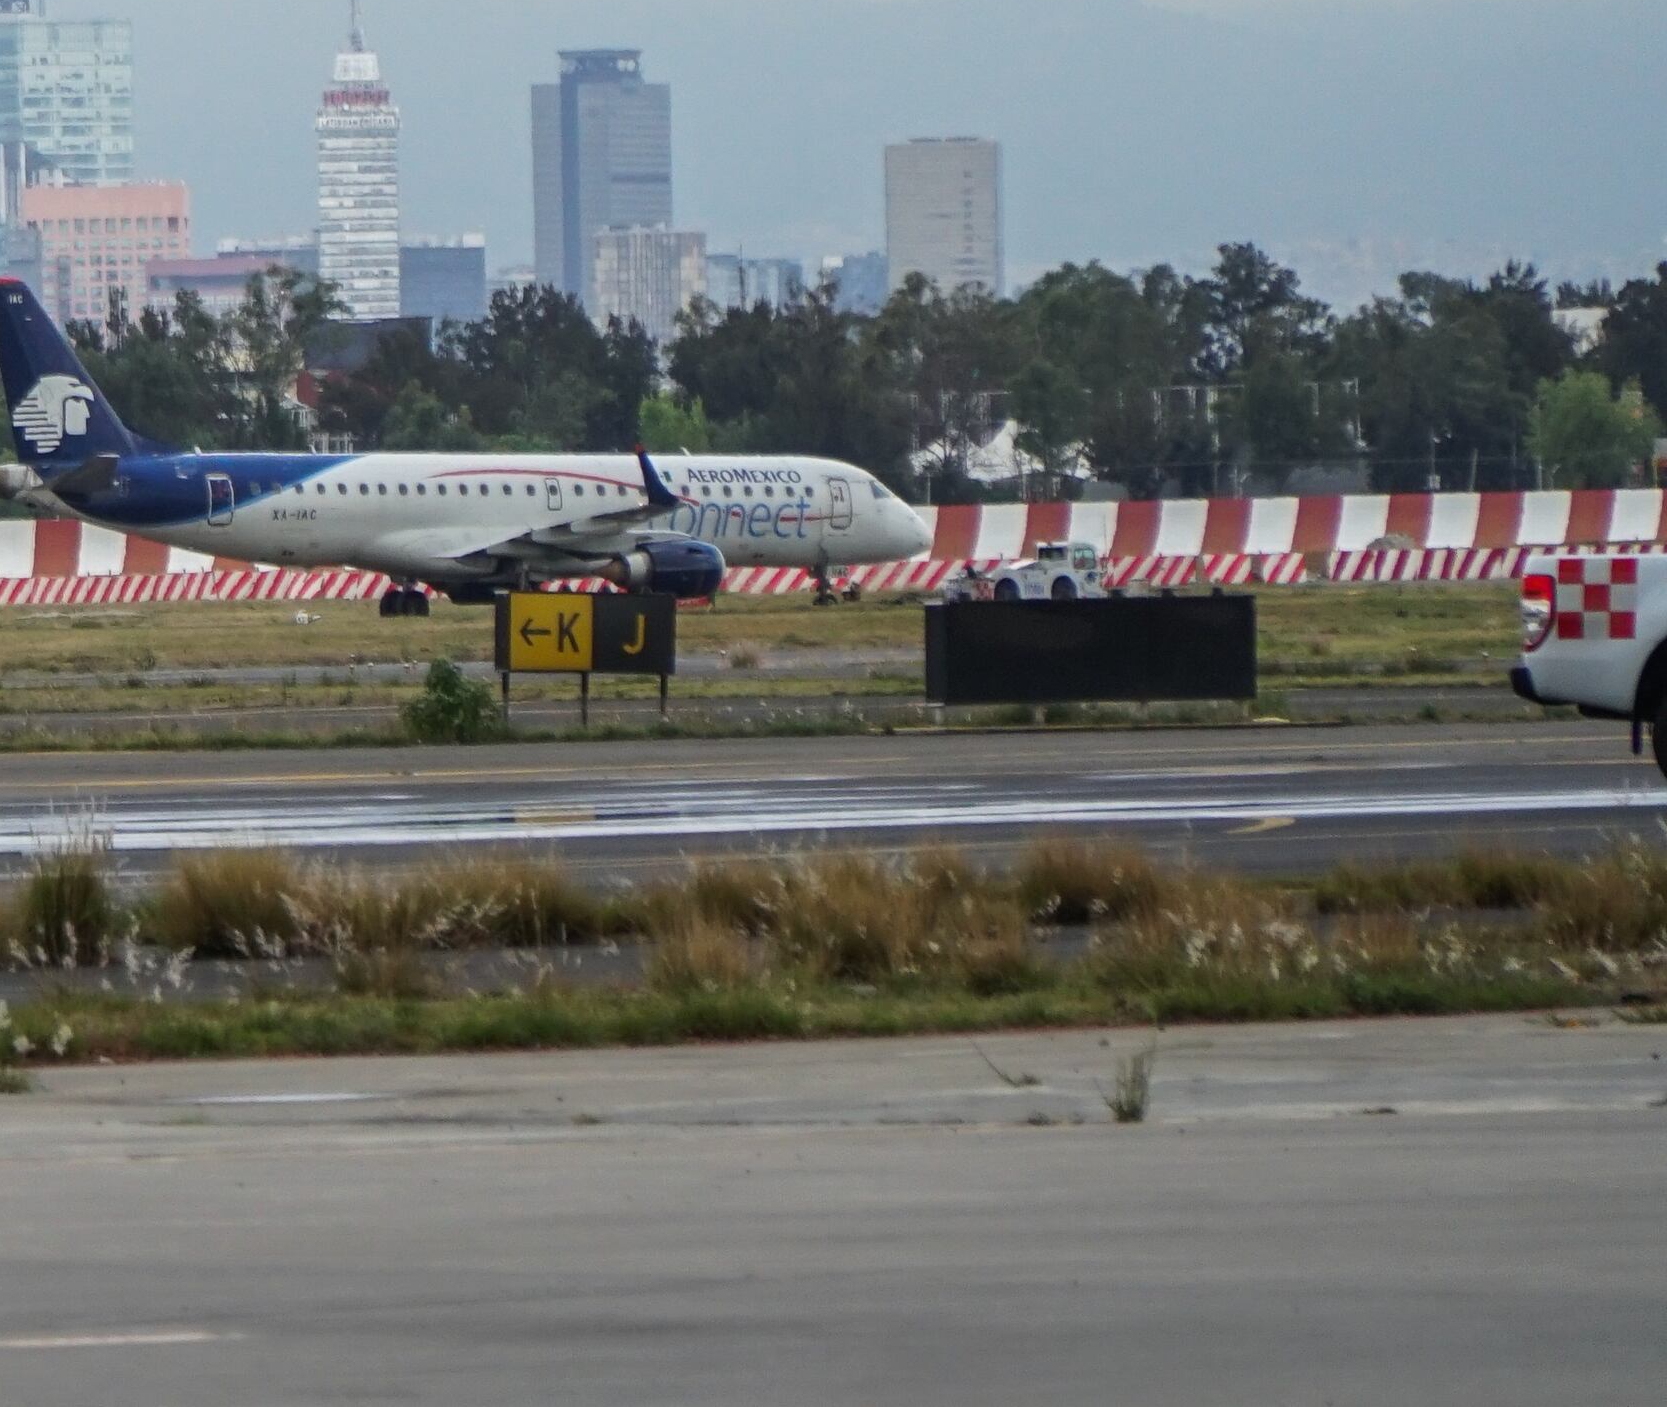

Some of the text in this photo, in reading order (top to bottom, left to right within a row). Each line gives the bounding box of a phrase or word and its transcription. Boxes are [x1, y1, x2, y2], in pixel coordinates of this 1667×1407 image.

[687, 468, 802, 484] AEROMEXICO
[647, 496, 811, 538] onnect
[556, 612, 646, 655] K J
